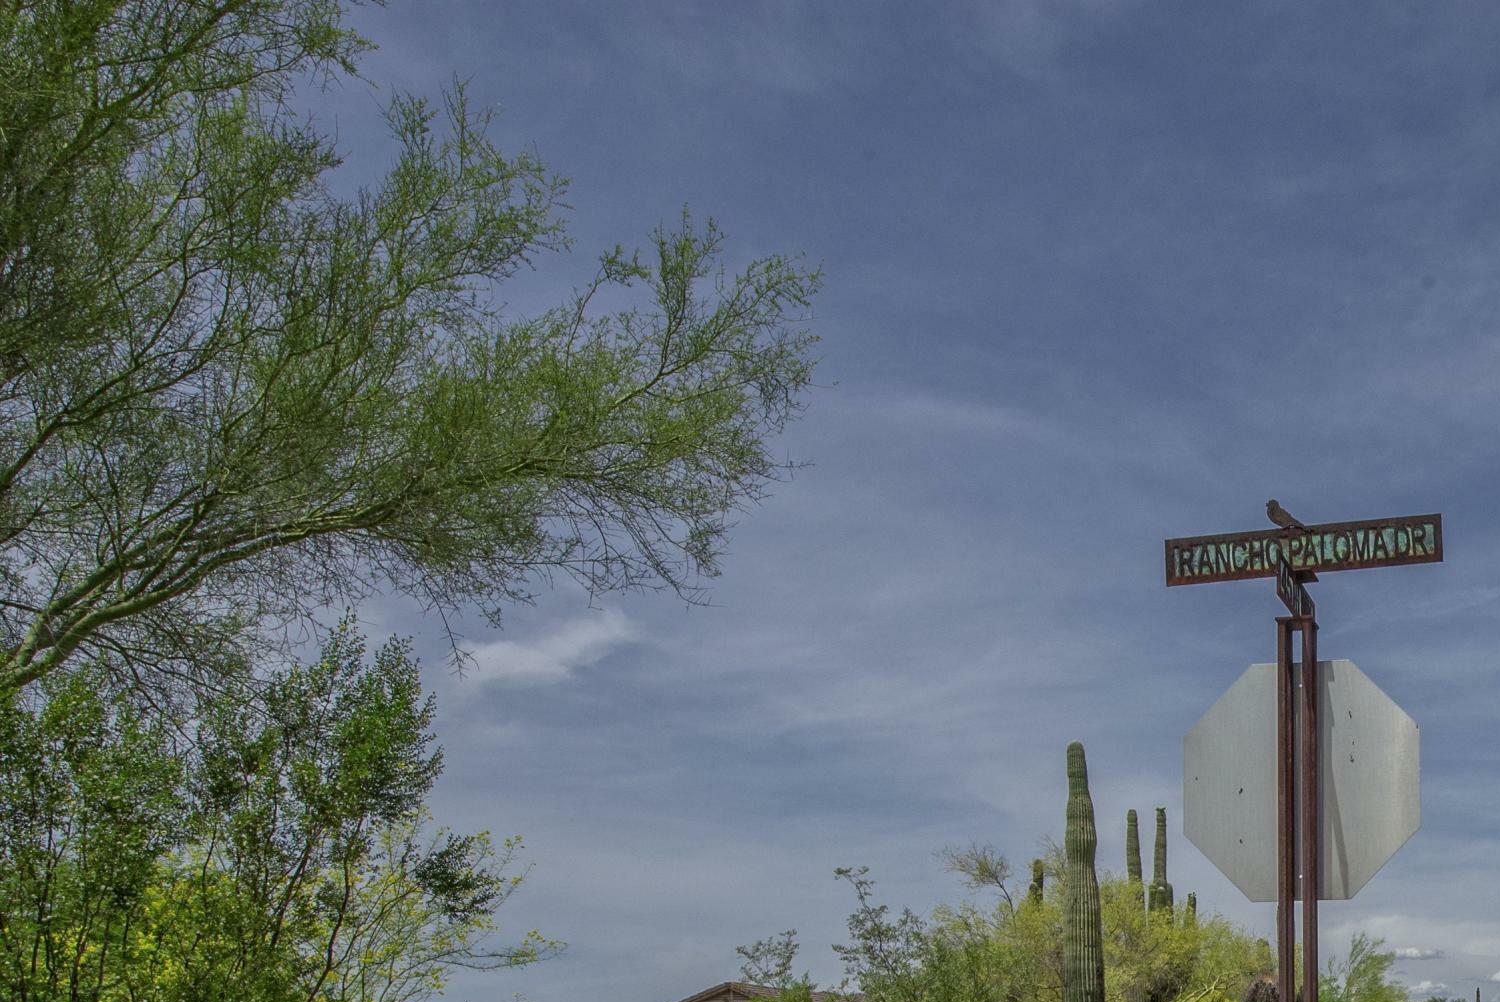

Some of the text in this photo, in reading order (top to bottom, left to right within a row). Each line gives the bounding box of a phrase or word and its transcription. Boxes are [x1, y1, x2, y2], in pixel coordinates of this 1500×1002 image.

[1173, 524, 1429, 577] RANCHO PALOMA DR
